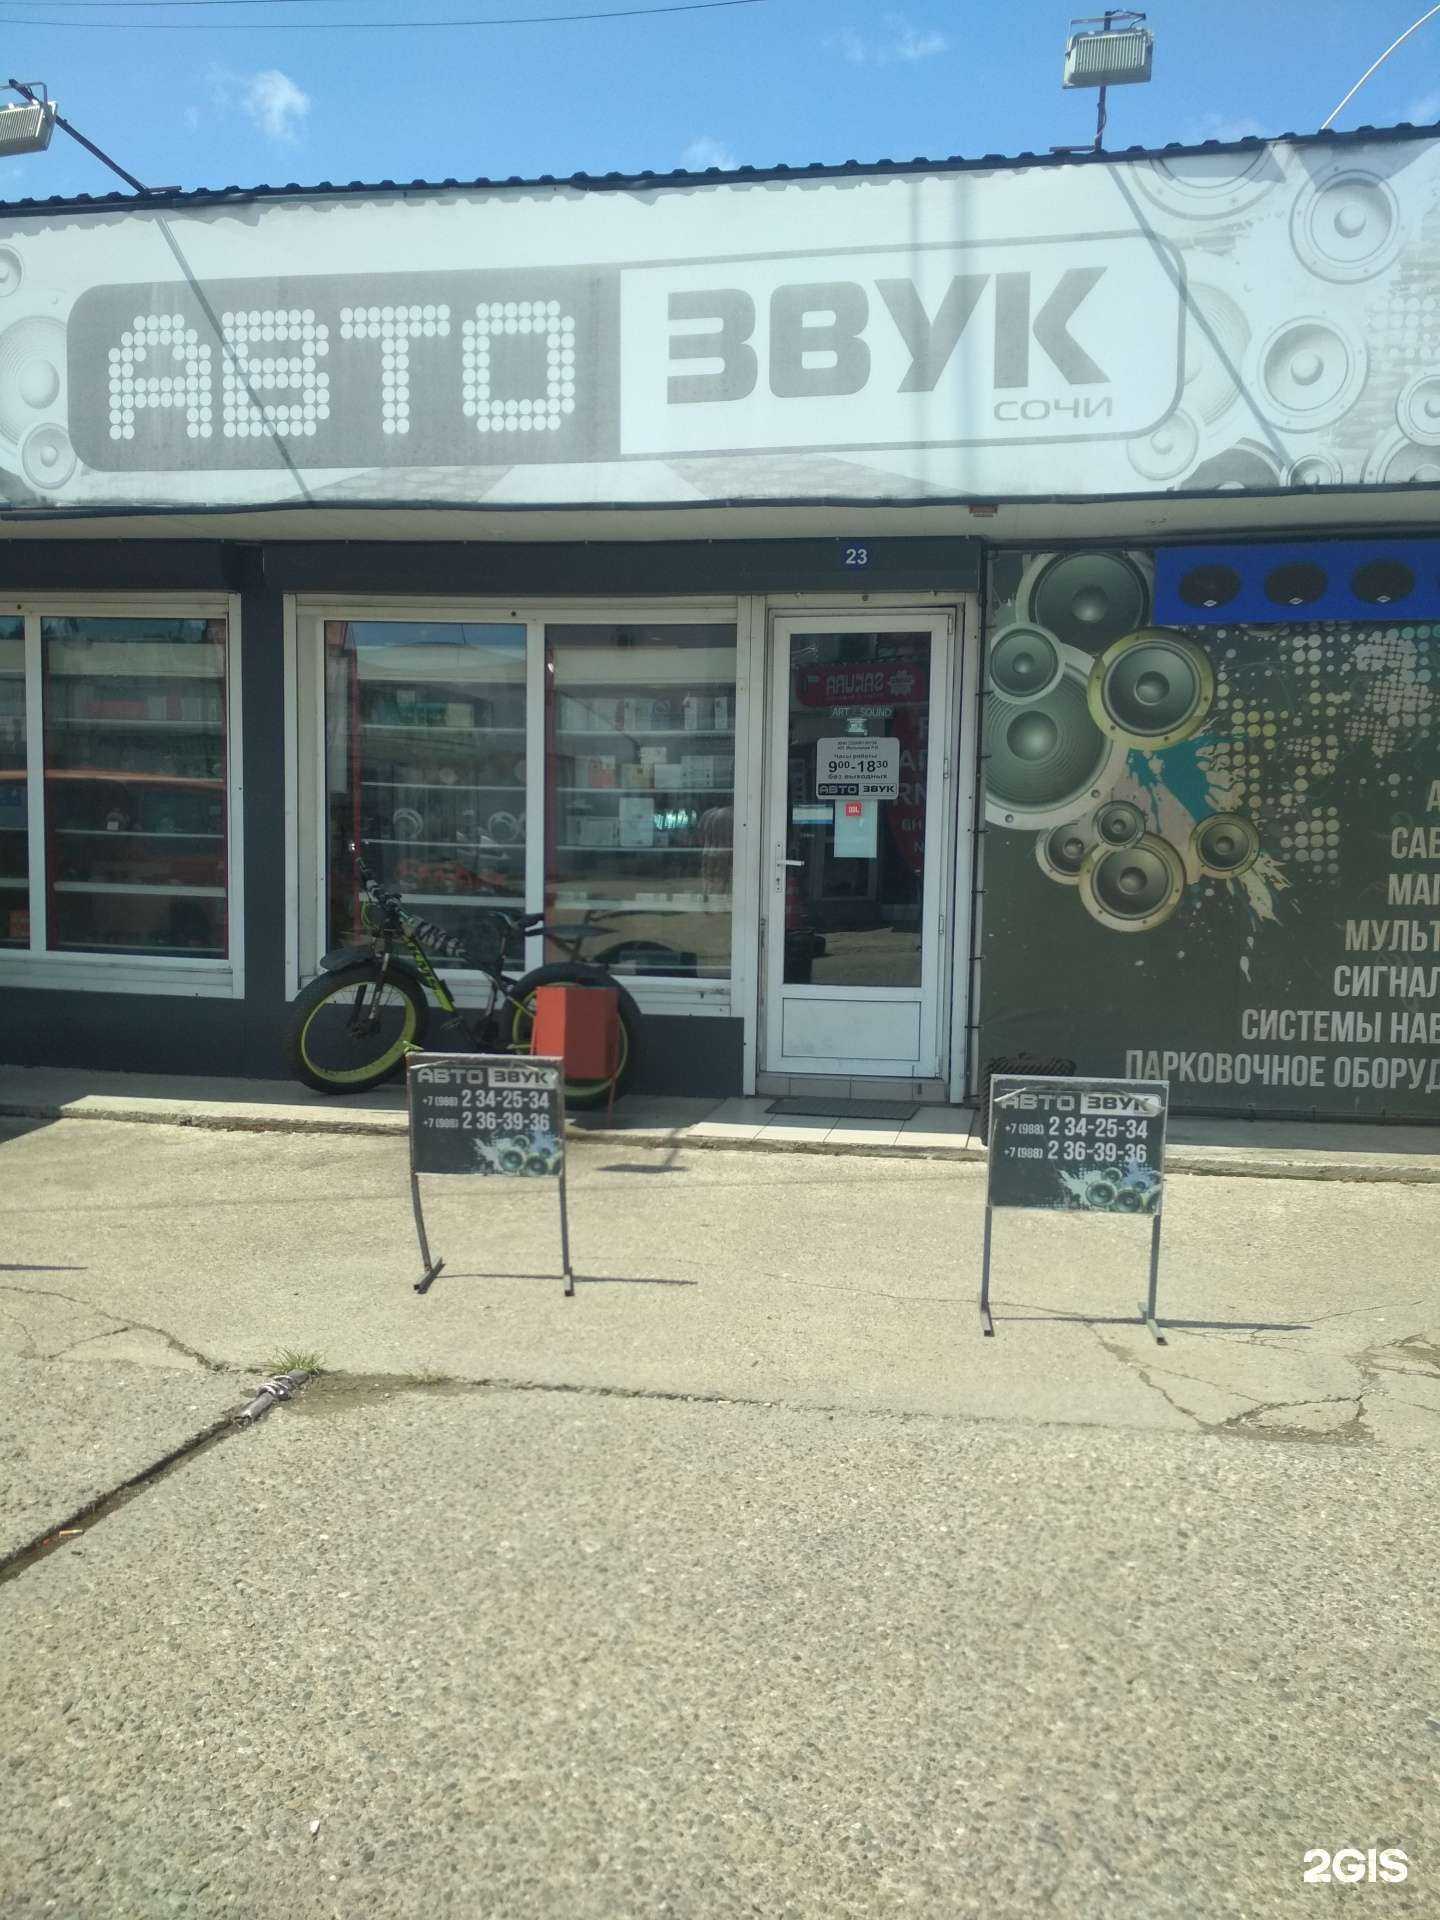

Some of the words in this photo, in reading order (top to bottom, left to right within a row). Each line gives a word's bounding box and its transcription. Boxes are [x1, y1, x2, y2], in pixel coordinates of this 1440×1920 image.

[108, 300, 576, 440] АВТО
[666, 266, 1111, 404] ЗВУК
[993, 396, 1113, 422] СОЧИ
[846, 549, 868, 564] 23
[820, 785, 857, 794] АВТО
[863, 785, 895, 793] ЗВУК
[1241, 1009, 1382, 1043] СИСТЕМЫ
[417, 1068, 484, 1085] АВТО
[494, 1069, 549, 1084] ЗВУК
[1125, 1050, 1326, 1087] ПАРКОВОЧНОЕ
[422, 1096, 434, 1107] +7
[462, 1089, 472, 1107] 2
[475, 1090, 550, 1110] 34-25-34
[1000, 1093, 1075, 1111] АВТО
[1087, 1096, 1149, 1112] ЗВУК
[423, 1118, 435, 1129] +7
[462, 1111, 472, 1129] 2
[476, 1112, 550, 1131] 36-39-36
[1005, 1123, 1017, 1133] +7
[1018, 1123, 1044, 1135] (988)
[1049, 1116, 1060, 1136] 2
[1064, 1117, 1148, 1139] 34-25-34
[1004, 1146, 1016, 1157] +7
[1017, 1147, 1043, 1159] (988)
[1047, 1141, 1059, 1160] 2
[1063, 1141, 1147, 1163] 36-39-36
